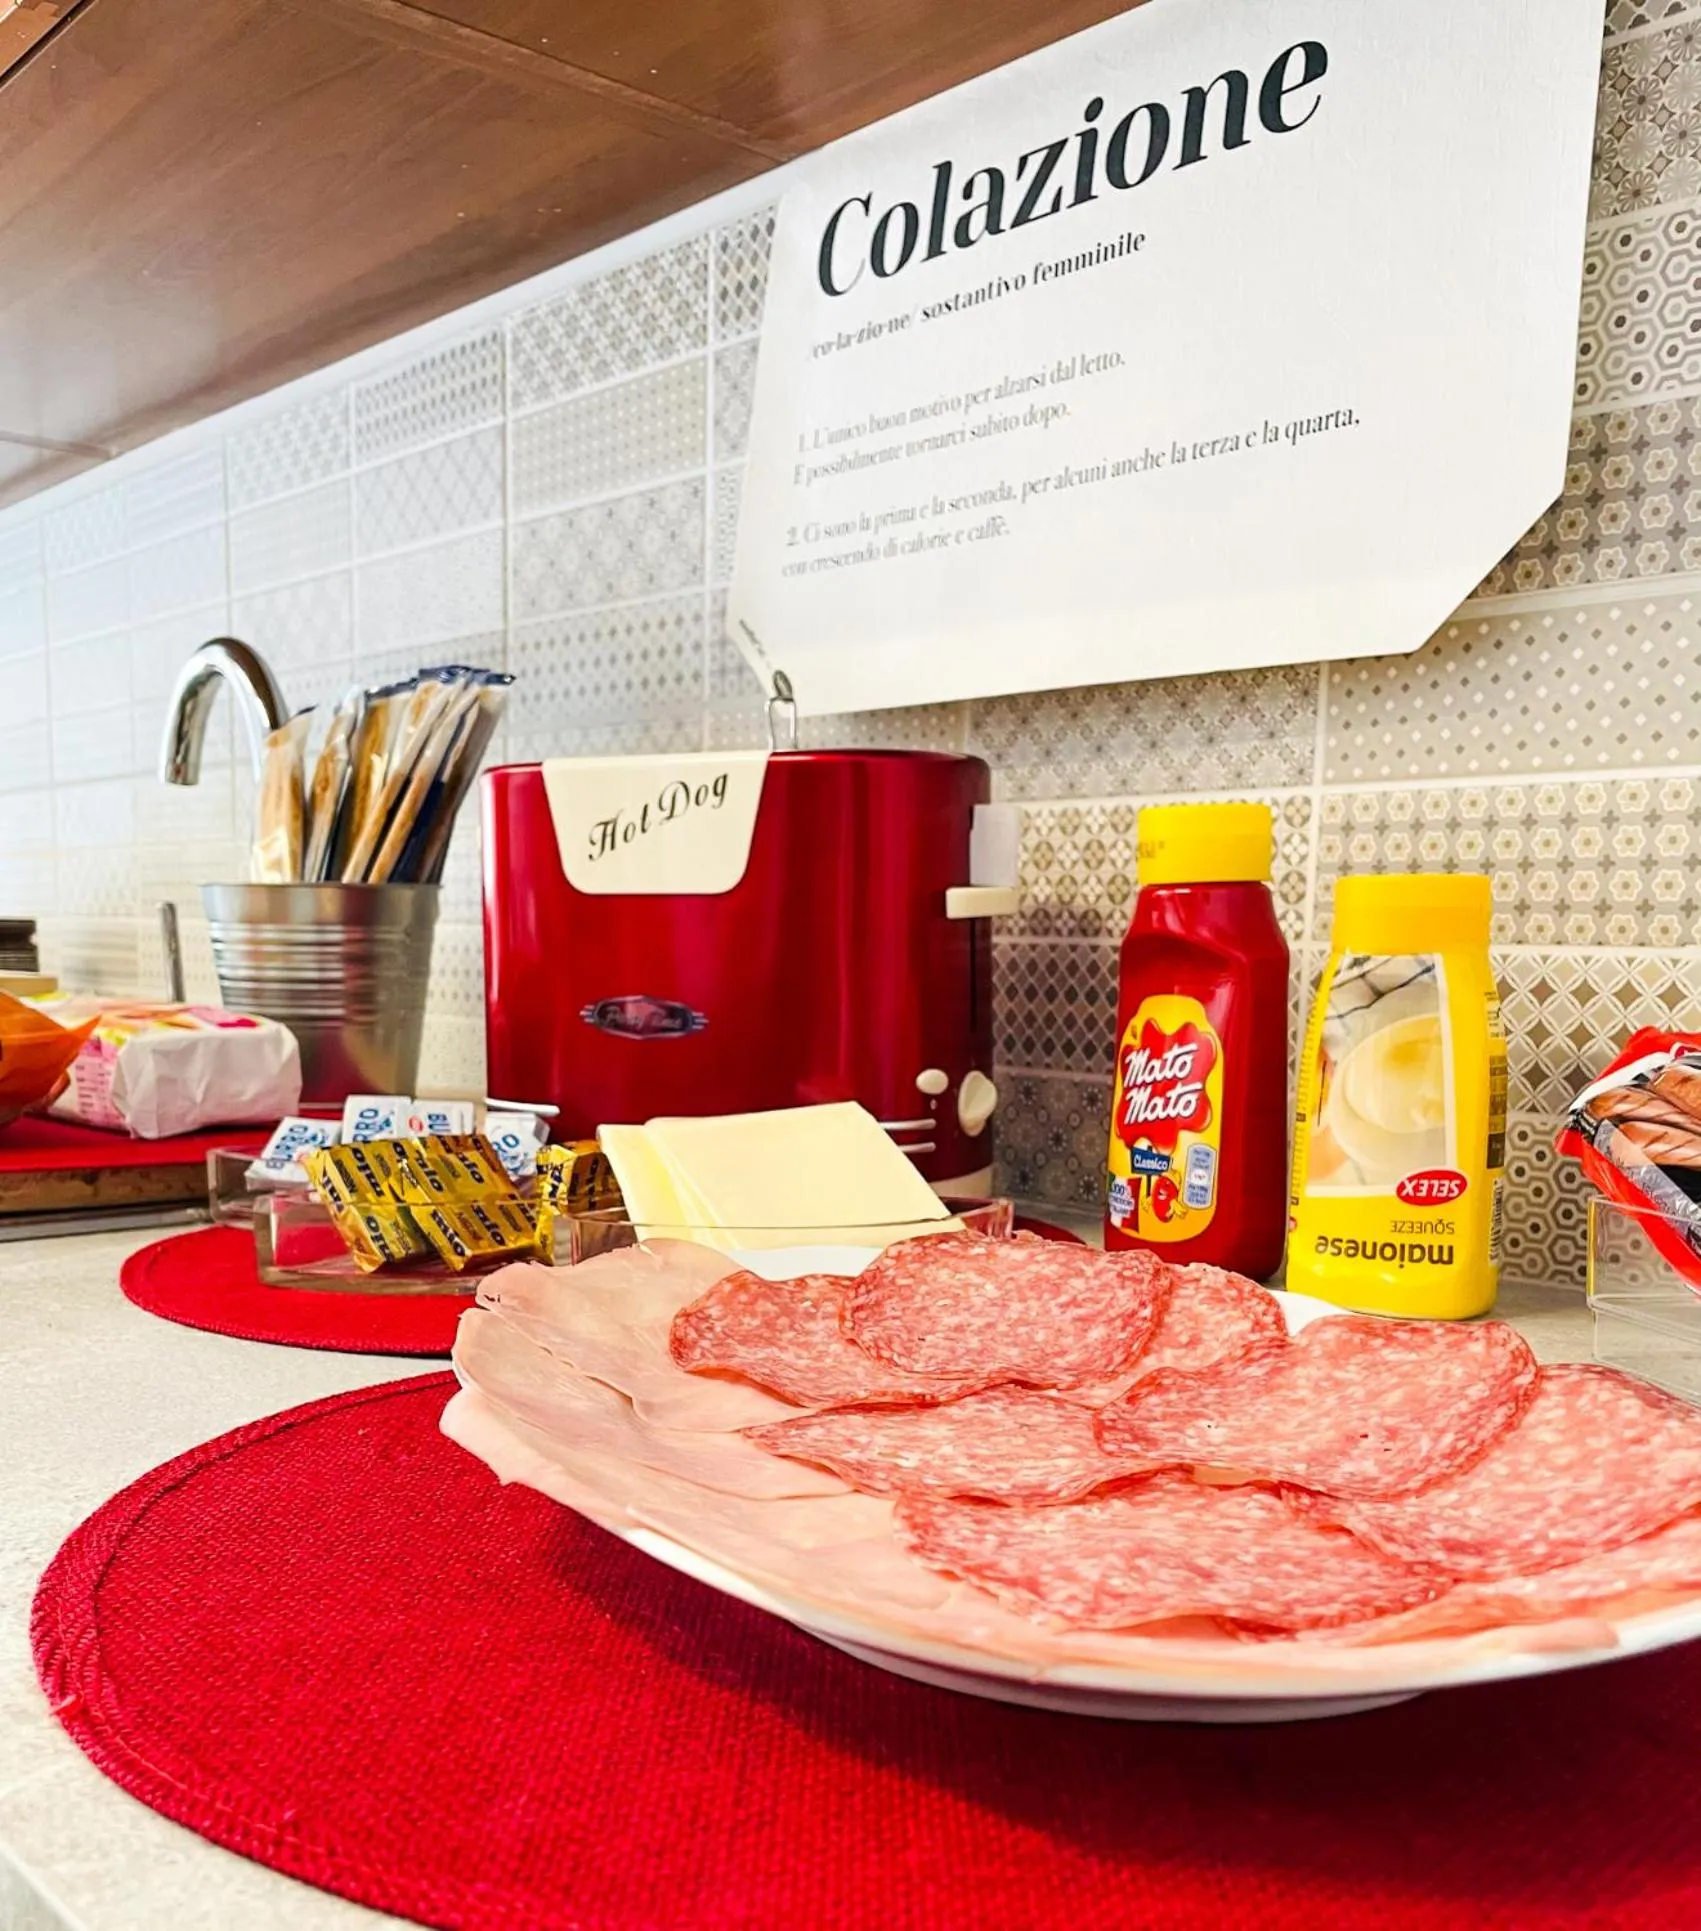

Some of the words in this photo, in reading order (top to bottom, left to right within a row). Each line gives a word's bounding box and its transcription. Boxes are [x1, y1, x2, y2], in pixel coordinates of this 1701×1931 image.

[816, 39, 1329, 298] Colazione
[920, 270, 1026, 322] sostantivo
[1032, 230, 1146, 287] femminile
[869, 413, 906, 434] buon
[909, 394, 961, 423] motivo
[964, 388, 991, 415] per
[994, 364, 1046, 399] alzarsi
[1049, 356, 1076, 384] dal
[1079, 351, 1126, 377] letto.
[905, 422, 966, 458] tornarci
[970, 411, 1020, 442] subito
[1023, 402, 1072, 430] dopo.
[873, 504, 917, 535] prima
[918, 504, 931, 519] e
[932, 495, 945, 517] la
[1022, 476, 1051, 504] per
[1054, 458, 1107, 491] alcuni
[1111, 447, 1166, 479] anche
[1171, 440, 1187, 465] la
[1191, 433, 1240, 462] terza
[1245, 430, 1257, 448] e
[1263, 419, 1280, 444] la
[1285, 407, 1361, 447] quarta,
[953, 529, 965, 545] e
[658, 772, 728, 826] Dog
[1124, 1043, 1198, 1088] Mato
[1124, 1082, 1203, 1125] Mato
[1400, 1178, 1461, 1198] SELEX
[1389, 1218, 1455, 1235] SQUEEZE
[1314, 1235, 1454, 1269] maionese
